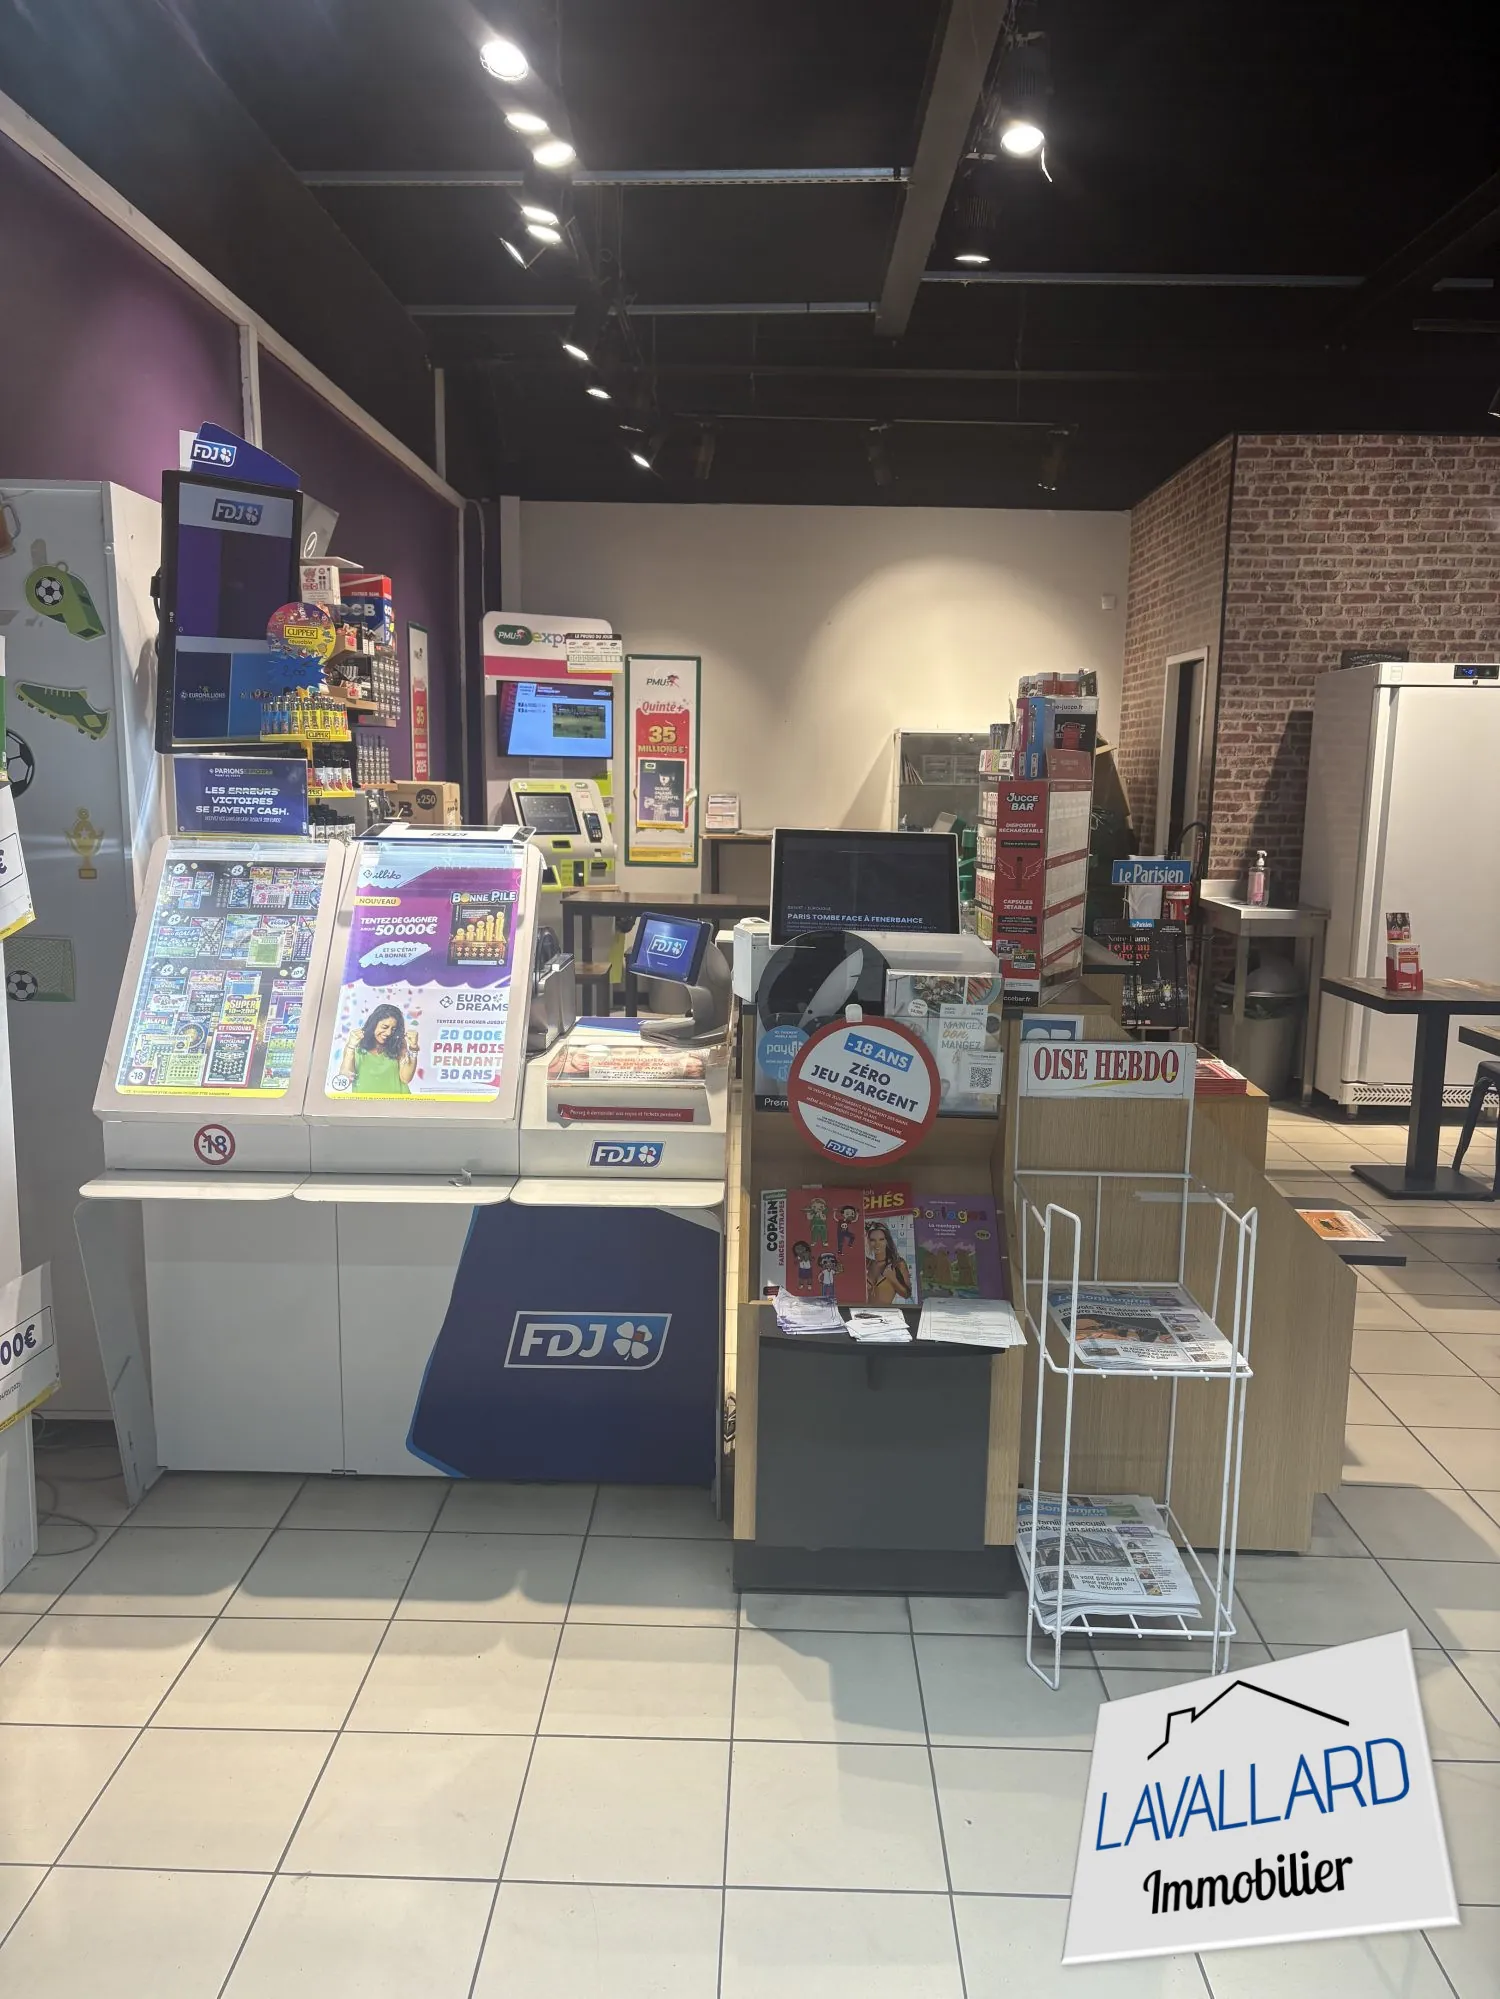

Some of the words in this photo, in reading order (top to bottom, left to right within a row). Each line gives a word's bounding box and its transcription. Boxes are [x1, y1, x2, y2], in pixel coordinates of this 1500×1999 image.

[193, 444, 219, 460] FDJ
[215, 503, 244, 520] FDJ
[287, 629, 316, 637] CLIPPER
[498, 631, 517, 640] PMU
[646, 678, 668, 686] PMU
[642, 701, 684, 714] Quinté+
[648, 726, 677, 744] 35
[638, 745, 678, 754] MILLIONS
[228, 787, 280, 796] ERREURS
[212, 797, 273, 805] VICTOIRES
[1007, 792, 1039, 802] JUCCE
[213, 806, 255, 814] PAYENT
[257, 807, 290, 815] CASH.
[1011, 803, 1034, 811] BAR
[372, 871, 402, 879] illiko
[1119, 868, 1132, 883] Le
[1133, 864, 1184, 883] Parisien
[491, 890, 517, 902] PILE
[864, 914, 870, 922] À
[871, 916, 923, 924] FENERBAHCE
[651, 938, 673, 953] FDJ
[457, 993, 491, 1002] EURO
[230, 1000, 256, 1009] SUPER
[456, 1003, 509, 1011] DREAMS
[440, 1030, 459, 1040] 20
[462, 1030, 502, 1041] 000€
[433, 1043, 463, 1053] PAR
[466, 1043, 504, 1054] MOIS
[942, 1041, 981, 1050] MANGEZ
[433, 1056, 503, 1066] PENDANT
[875, 1047, 909, 1068] ANS
[1033, 1046, 1088, 1081] OISE
[1094, 1049, 1180, 1084] HEBDO
[131, 1072, 143, 1080] -18
[440, 1069, 460, 1080] 30
[462, 1070, 492, 1080] ANS
[848, 1061, 891, 1085] ZÉRO
[811, 1064, 840, 1084] JEU
[841, 1076, 919, 1113] D'ARGENT
[201, 1133, 228, 1153] -18
[827, 1142, 844, 1152] FDJ
[595, 1146, 637, 1163] FDJ
[520, 1323, 607, 1358] FDJ
